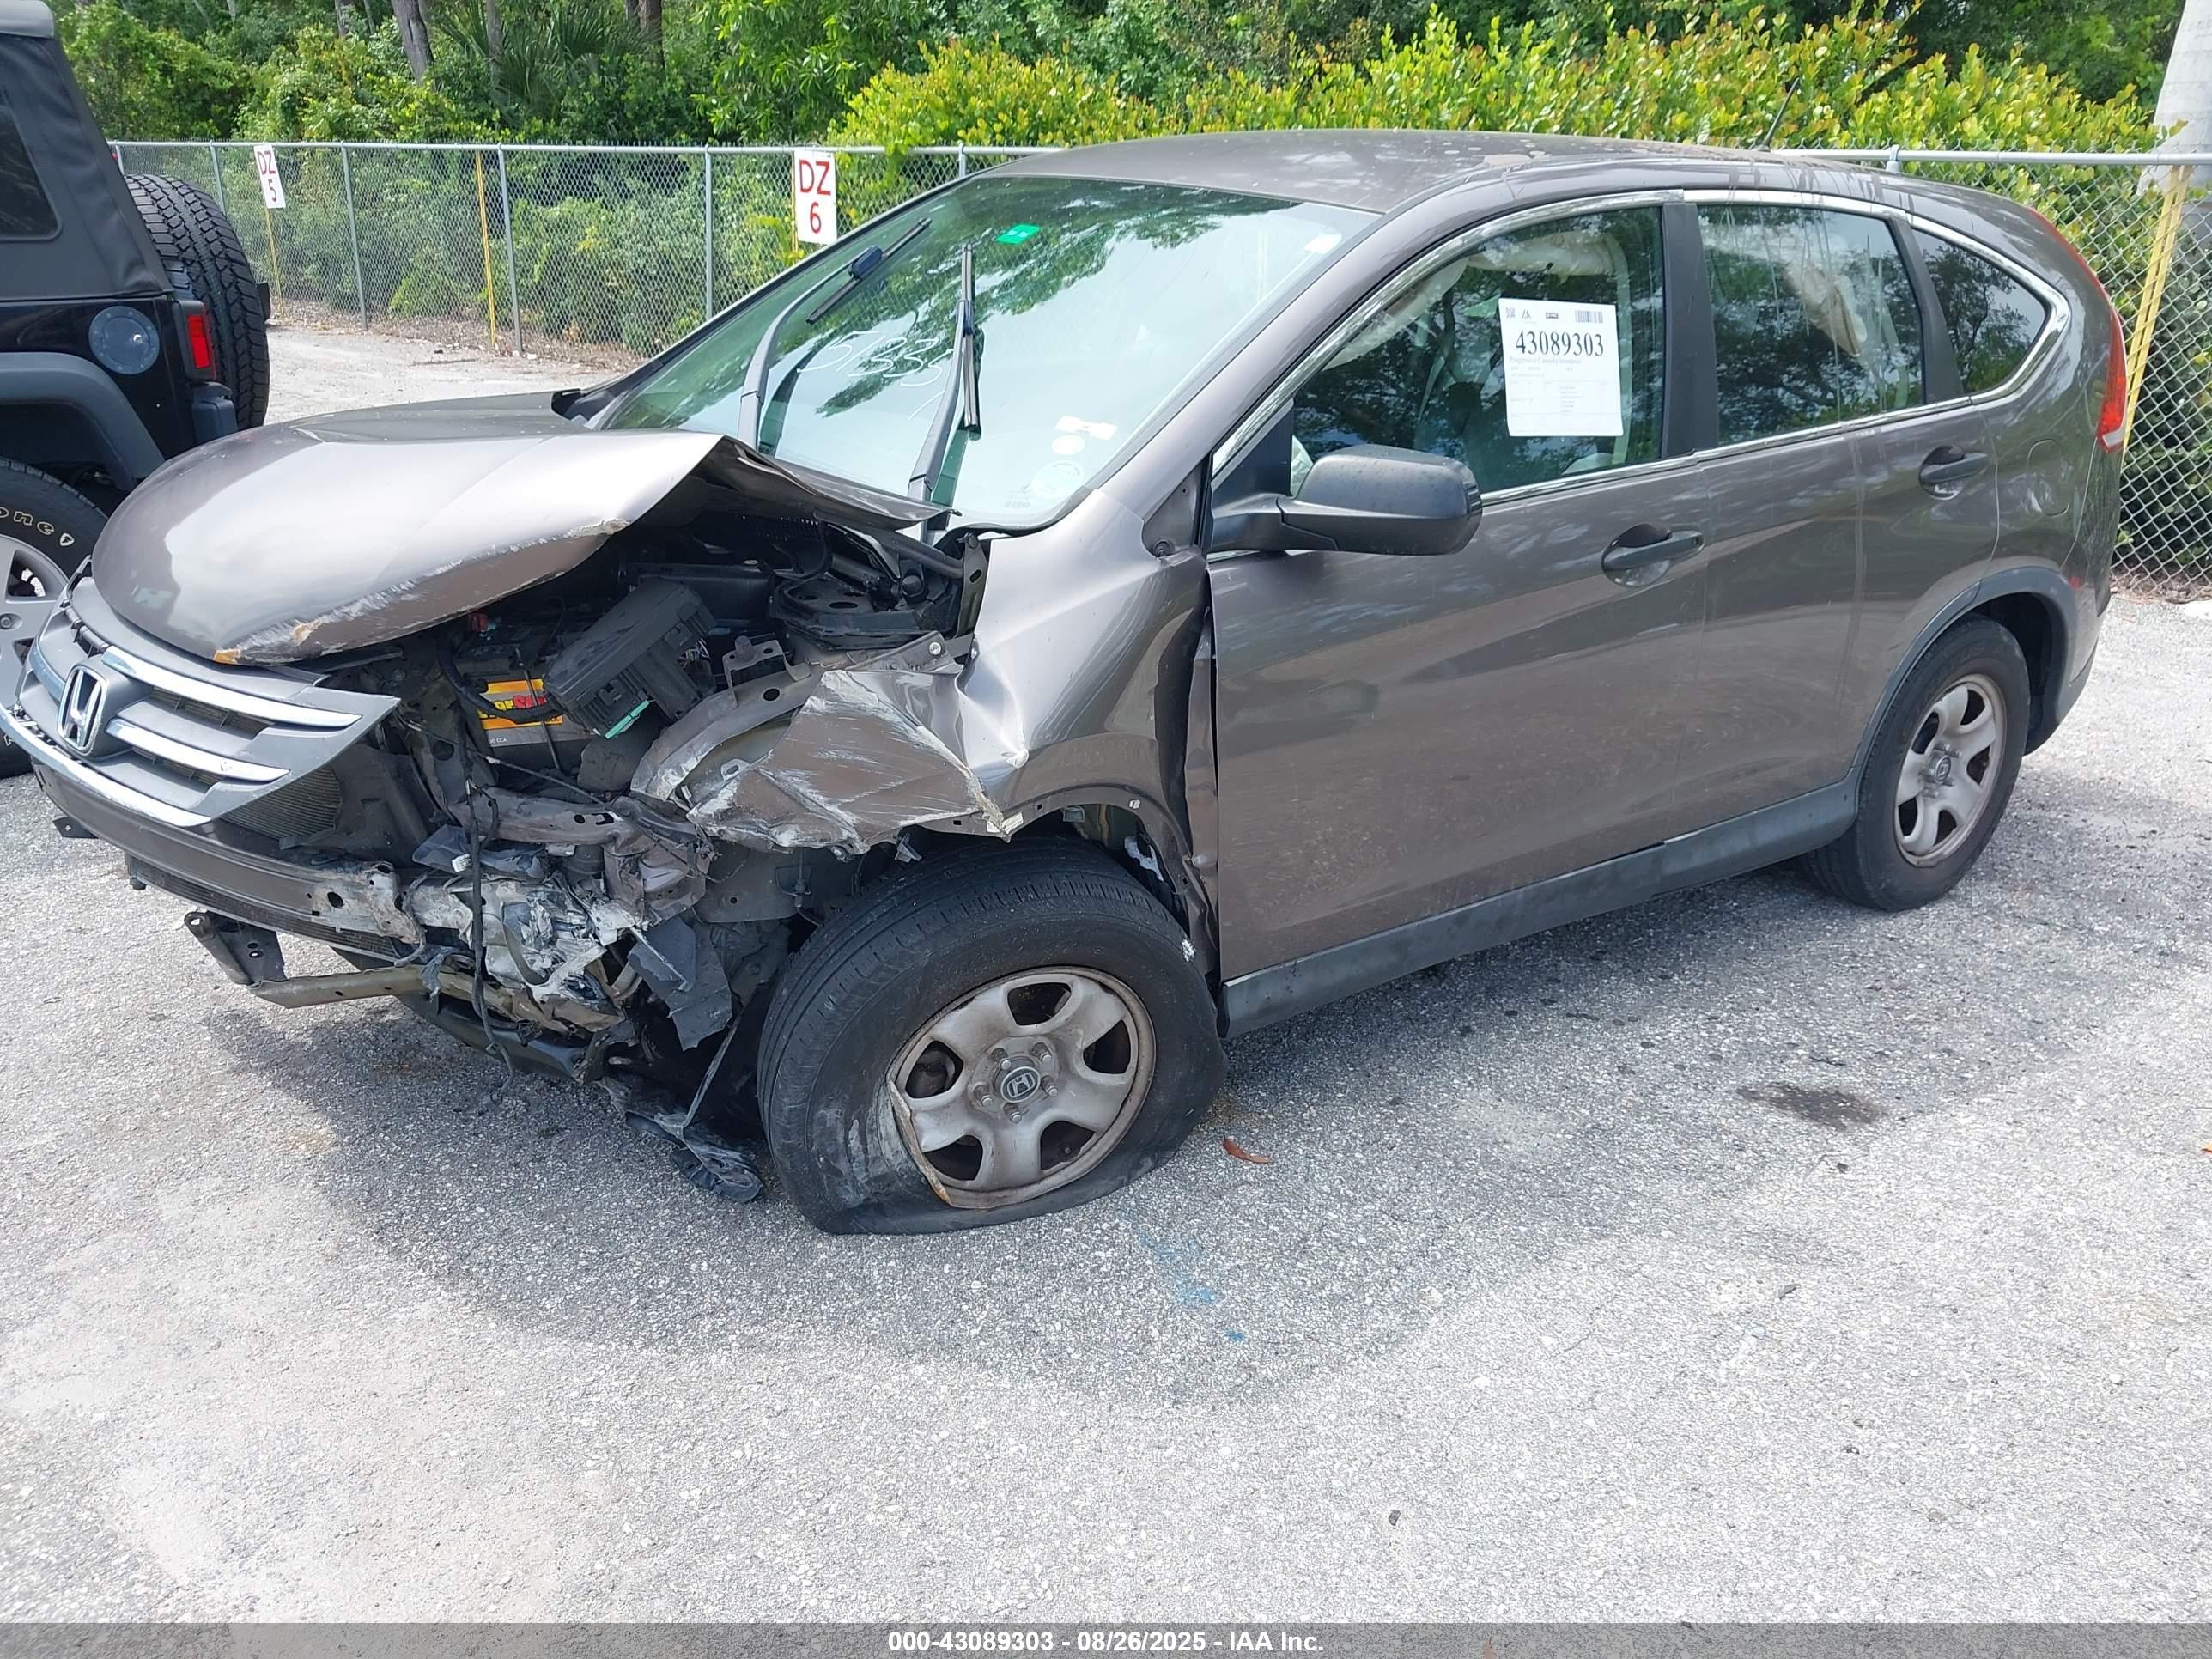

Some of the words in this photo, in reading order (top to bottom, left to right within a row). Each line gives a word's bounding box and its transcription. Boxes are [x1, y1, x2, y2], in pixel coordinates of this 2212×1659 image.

[257, 150, 276, 175] DZ
[268, 179, 277, 202] 5
[799, 160, 831, 196] DZ
[810, 201, 822, 234] 6
[1516, 330, 1604, 356] 43089303
